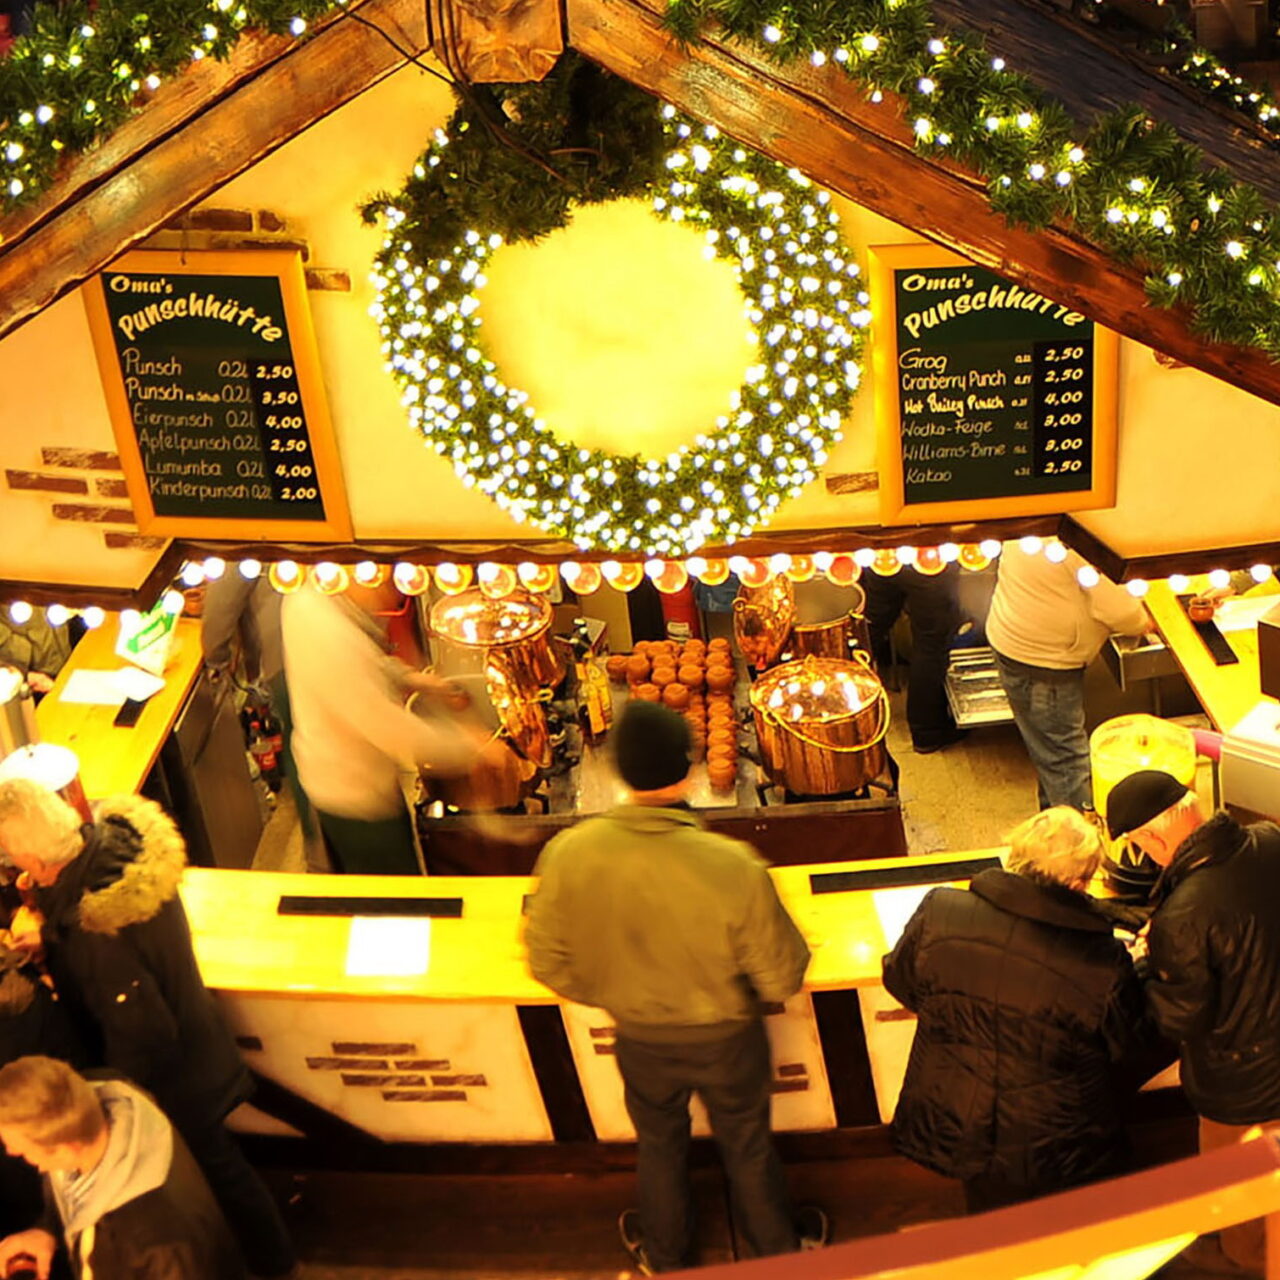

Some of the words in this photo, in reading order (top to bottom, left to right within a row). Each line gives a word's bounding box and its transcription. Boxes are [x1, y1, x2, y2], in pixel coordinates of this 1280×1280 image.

[110, 275, 173, 294] Oma's
[902, 273, 974, 292] Oma's
[118, 292, 283, 342] Punschhütte
[122, 347, 182, 376] Punsch
[256, 365, 293, 380] 2,50
[899, 347, 948, 375] Grog
[1044, 347, 1084, 362] 2,50
[125, 376, 184, 401] Punsch
[262, 391, 298, 405] 3,50
[902, 372, 967, 392] Cranberry
[969, 370, 1007, 388] Punch
[1044, 368, 1084, 383] 2,50
[904, 398, 924, 415] Hot
[1044, 391, 1083, 406] 4,00
[133, 402, 213, 431] Eierpunsch
[265, 417, 302, 430] 4,00
[902, 419, 994, 439] Wodka-Feige
[1044, 413, 1082, 427] 3,00
[139, 428, 231, 455] Apfelpunsch
[270, 439, 307, 453] 2,50
[1045, 438, 1083, 452] 3,00
[145, 453, 222, 476] Lumumba
[275, 464, 312, 479] 4,00
[906, 467, 952, 484] Kakao
[1044, 460, 1082, 474] 2,50
[149, 476, 249, 502] Kinderpunsch
[280, 487, 317, 501] 2,00
